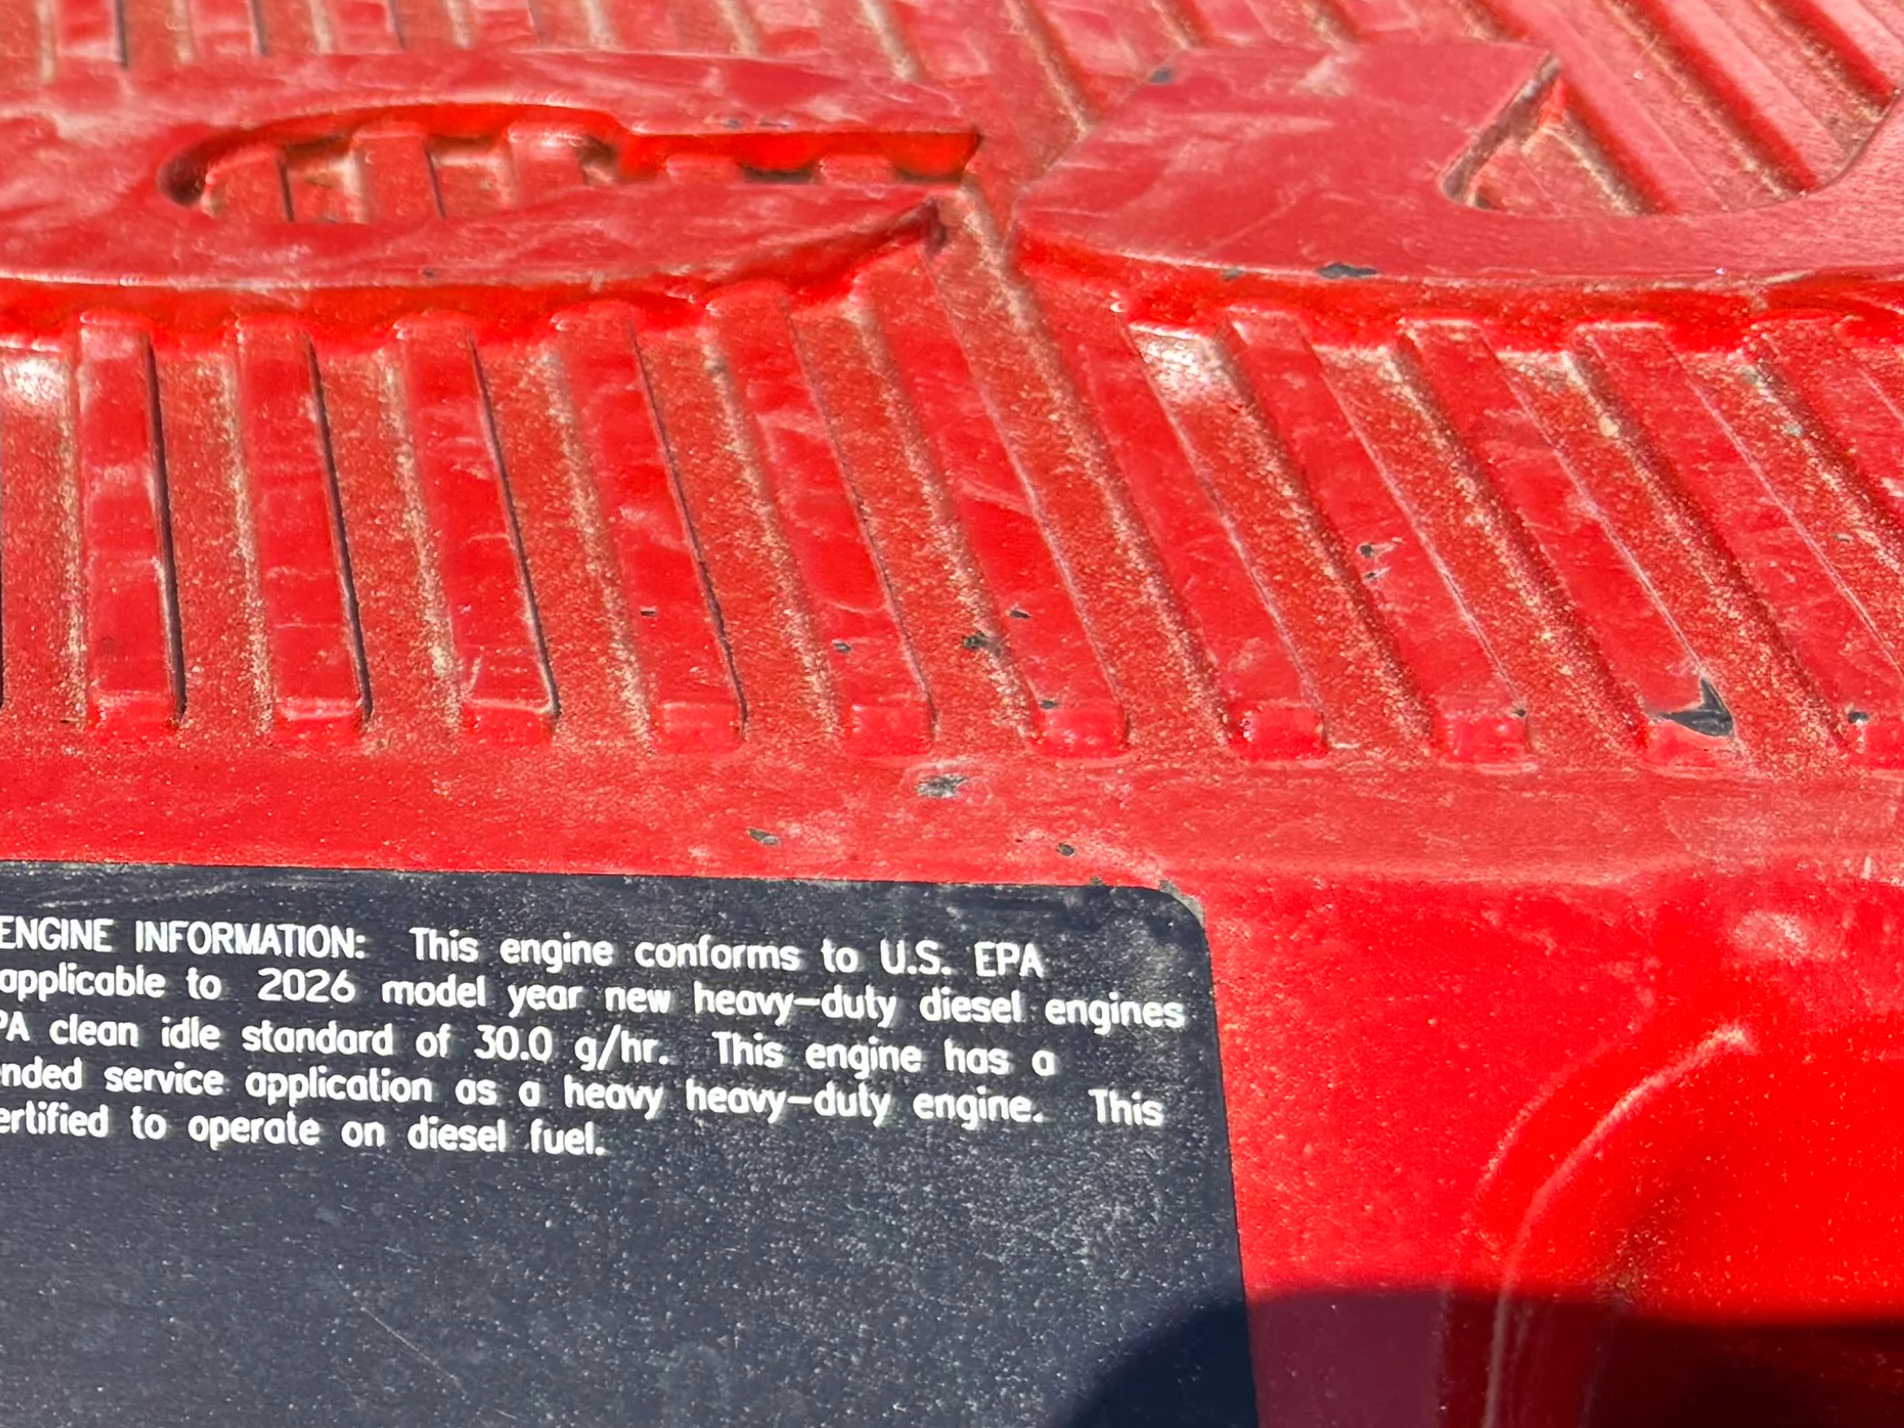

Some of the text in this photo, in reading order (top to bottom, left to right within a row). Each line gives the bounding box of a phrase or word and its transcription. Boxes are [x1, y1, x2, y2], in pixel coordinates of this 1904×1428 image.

[134, 919, 367, 961] INFORMATION:
[409, 926, 480, 965] This
[499, 932, 615, 977] engine
[634, 933, 801, 973] conforms
[821, 938, 860, 975] to
[880, 940, 953, 976] U.S.
[974, 941, 1045, 979] EPA
[186, 967, 222, 1002] to
[257, 967, 357, 1004] 2026
[381, 972, 487, 1009] model
[507, 984, 583, 1018] year
[604, 986, 672, 1016] new
[693, 984, 898, 1026] heavy-duty
[919, 987, 1023, 1024] diesel
[1044, 994, 1186, 1033] engines
[49, 1012, 140, 1048] clean
[160, 1016, 221, 1052] idle
[241, 1020, 394, 1057] standard
[415, 1024, 452, 1058] of
[473, 1026, 554, 1064] 30.0
[573, 1027, 670, 1071] g/hr.
[713, 1031, 785, 1070] This
[804, 1034, 923, 1079] engine
[943, 1040, 1010, 1077] has
[1030, 1048, 1057, 1079] a
[103, 1060, 225, 1096] service
[244, 1063, 433, 1106] application
[455, 1079, 498, 1108] as
[518, 1080, 542, 1109] a
[562, 1074, 664, 1118] heavy
[685, 1079, 892, 1126] heavy-duty
[912, 1086, 1045, 1130] engine.
[1092, 1090, 1164, 1127] This
[130, 1106, 168, 1140] to
[187, 1111, 321, 1151] operate
[341, 1121, 386, 1149] on
[408, 1115, 508, 1153] diesel
[529, 1119, 608, 1157] fuel.
